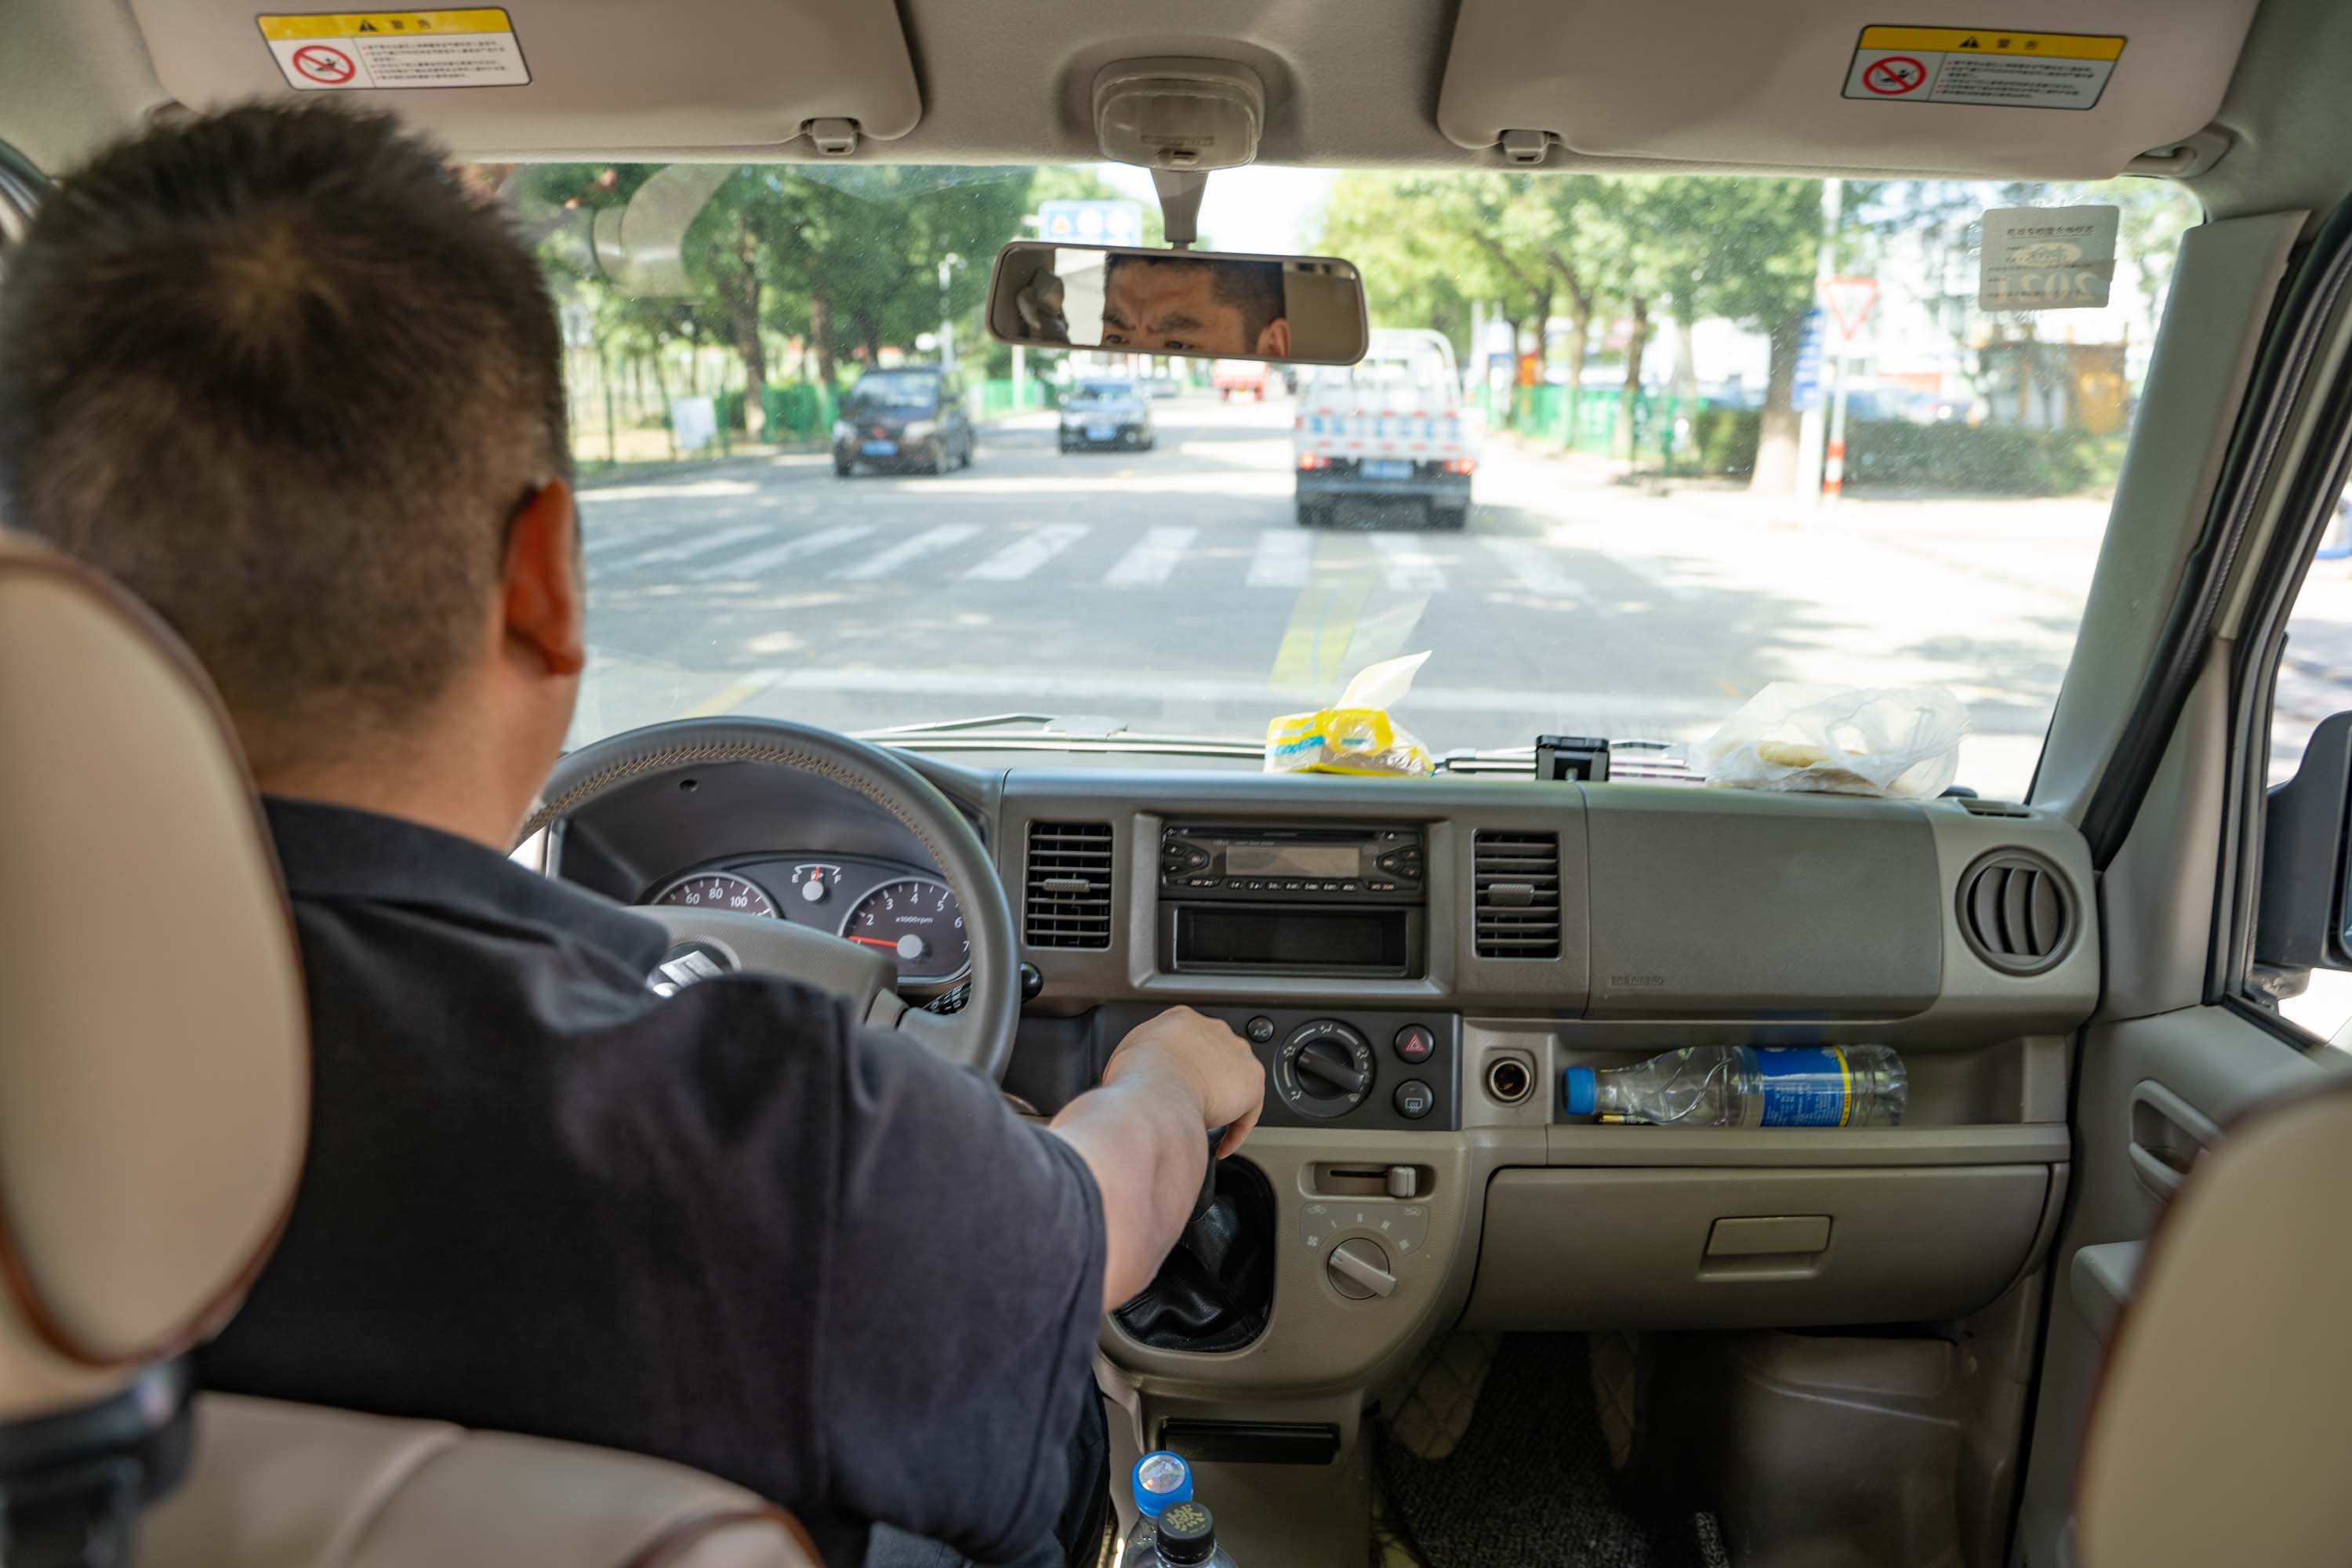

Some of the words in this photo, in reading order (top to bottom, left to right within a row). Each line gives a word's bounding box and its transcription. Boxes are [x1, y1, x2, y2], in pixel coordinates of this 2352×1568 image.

[791, 873, 800, 884] E
[833, 874, 842, 884] F
[685, 892, 701, 905] 60
[708, 887, 724, 900] 80
[909, 892, 919, 905] 4
[730, 895, 748, 908] 100
[885, 898, 894, 911] 3
[936, 899, 945, 912] 5
[866, 913, 874, 926] 2
[954, 916, 963, 928] 6
[962, 940, 970, 953] 7
[1254, 1028, 1268, 1037] A/C
